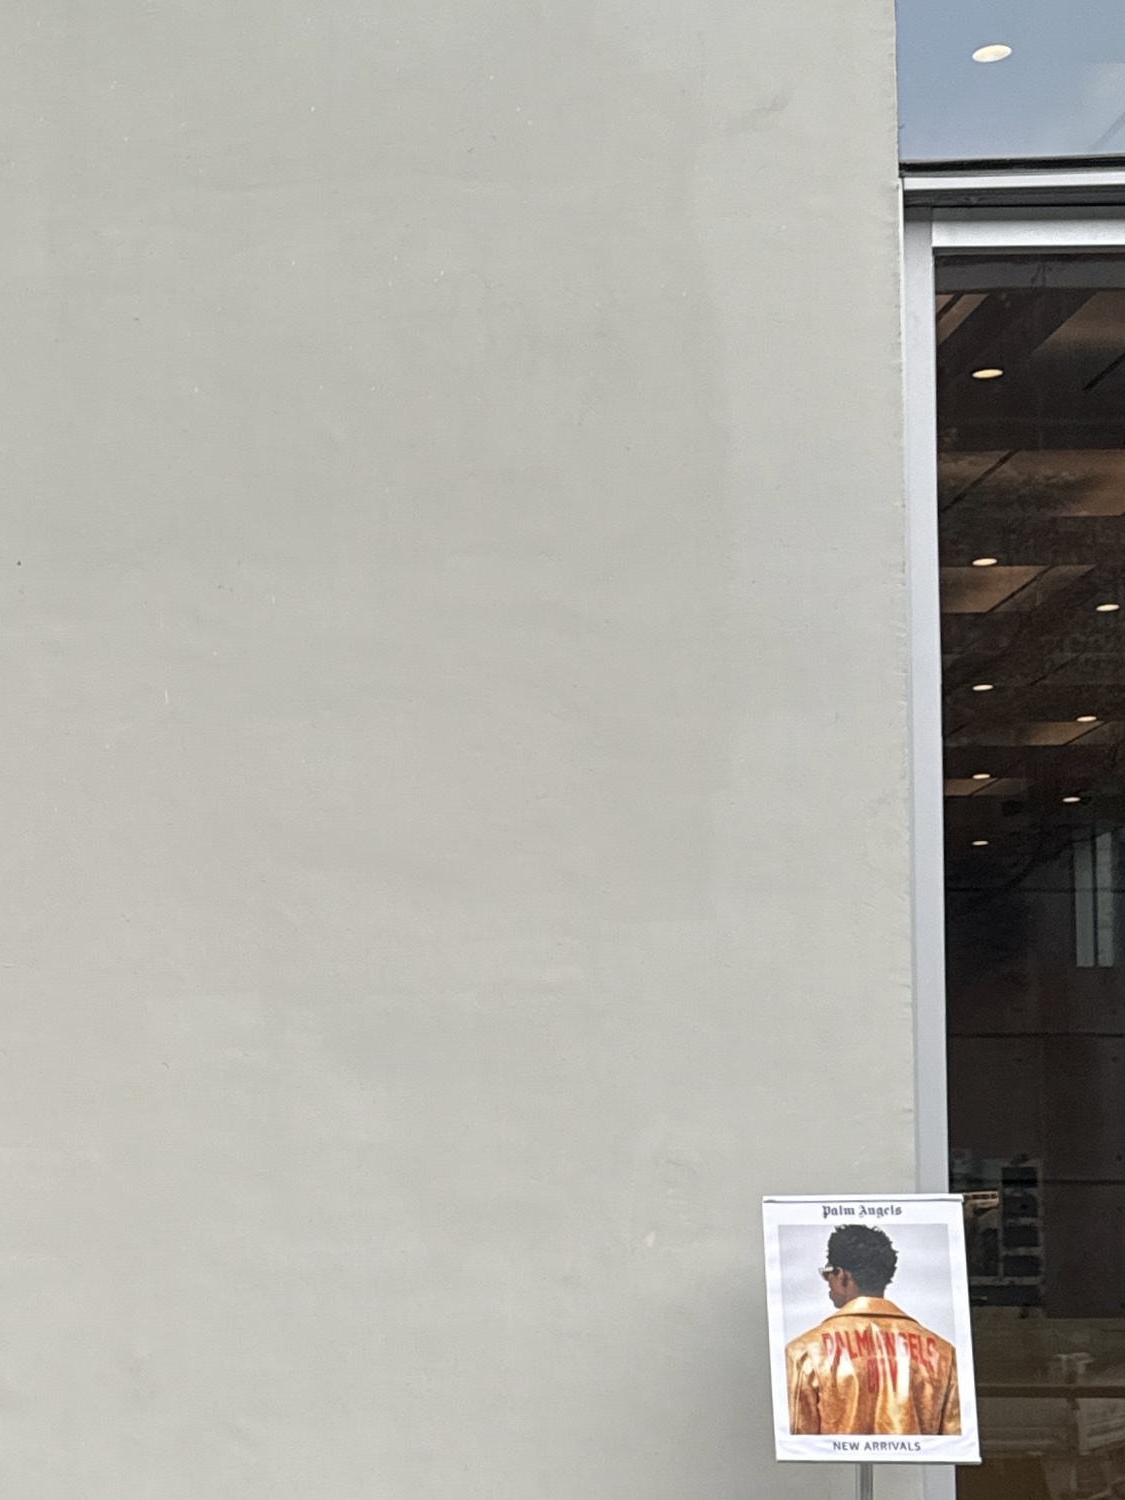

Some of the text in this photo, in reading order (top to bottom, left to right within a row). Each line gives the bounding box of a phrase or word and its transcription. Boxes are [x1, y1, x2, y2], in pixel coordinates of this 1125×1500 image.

[822, 1204, 903, 1219] Palm Angels
[833, 1441, 921, 1452] NEW ARRIVALS
